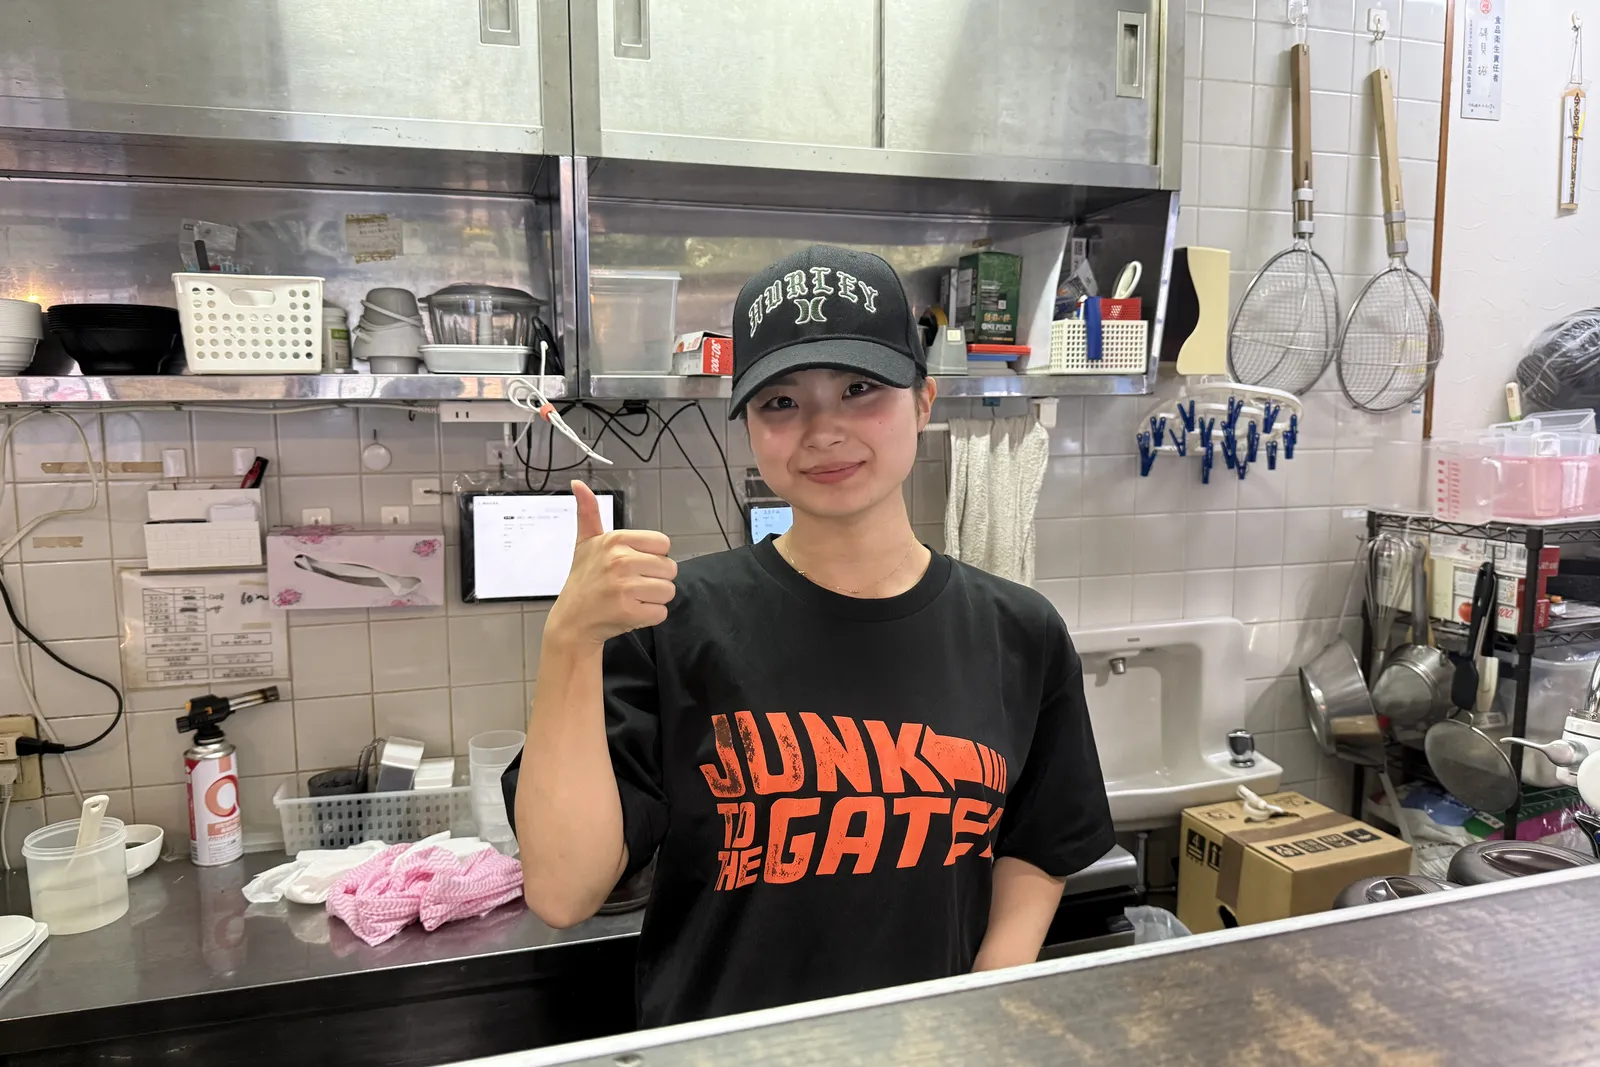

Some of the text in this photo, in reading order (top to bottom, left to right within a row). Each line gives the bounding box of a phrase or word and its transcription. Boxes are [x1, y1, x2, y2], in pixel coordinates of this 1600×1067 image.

[748, 266, 879, 338] HURLEY
[699, 711, 945, 797] JUNK
[717, 802, 755, 850] TO
[715, 847, 762, 891] THE
